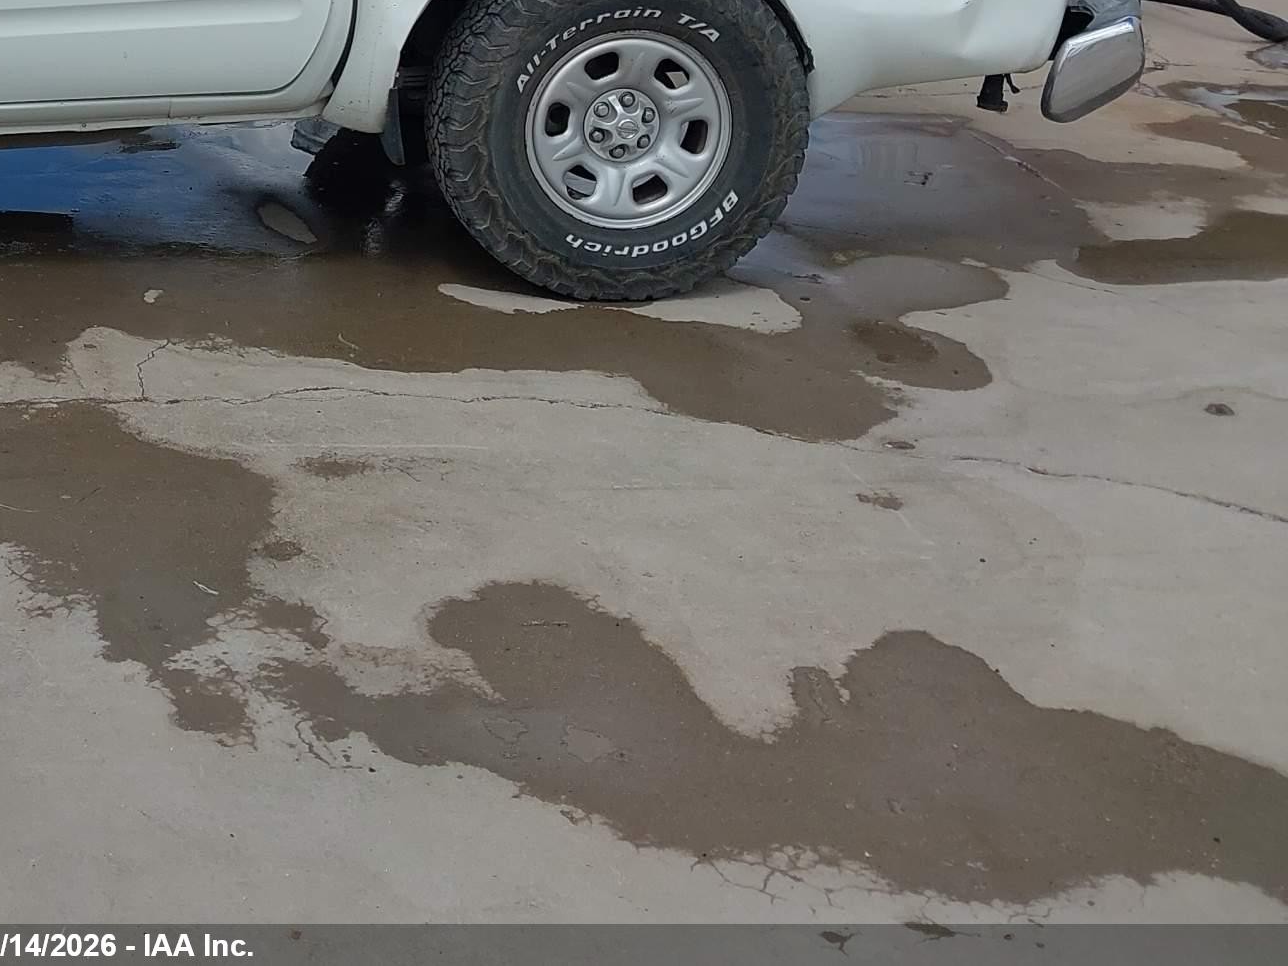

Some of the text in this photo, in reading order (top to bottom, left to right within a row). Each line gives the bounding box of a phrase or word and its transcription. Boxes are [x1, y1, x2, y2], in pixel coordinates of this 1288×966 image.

[516, 7, 721, 94] All-Terrain T/A
[565, 188, 740, 259] BFGoodrich
